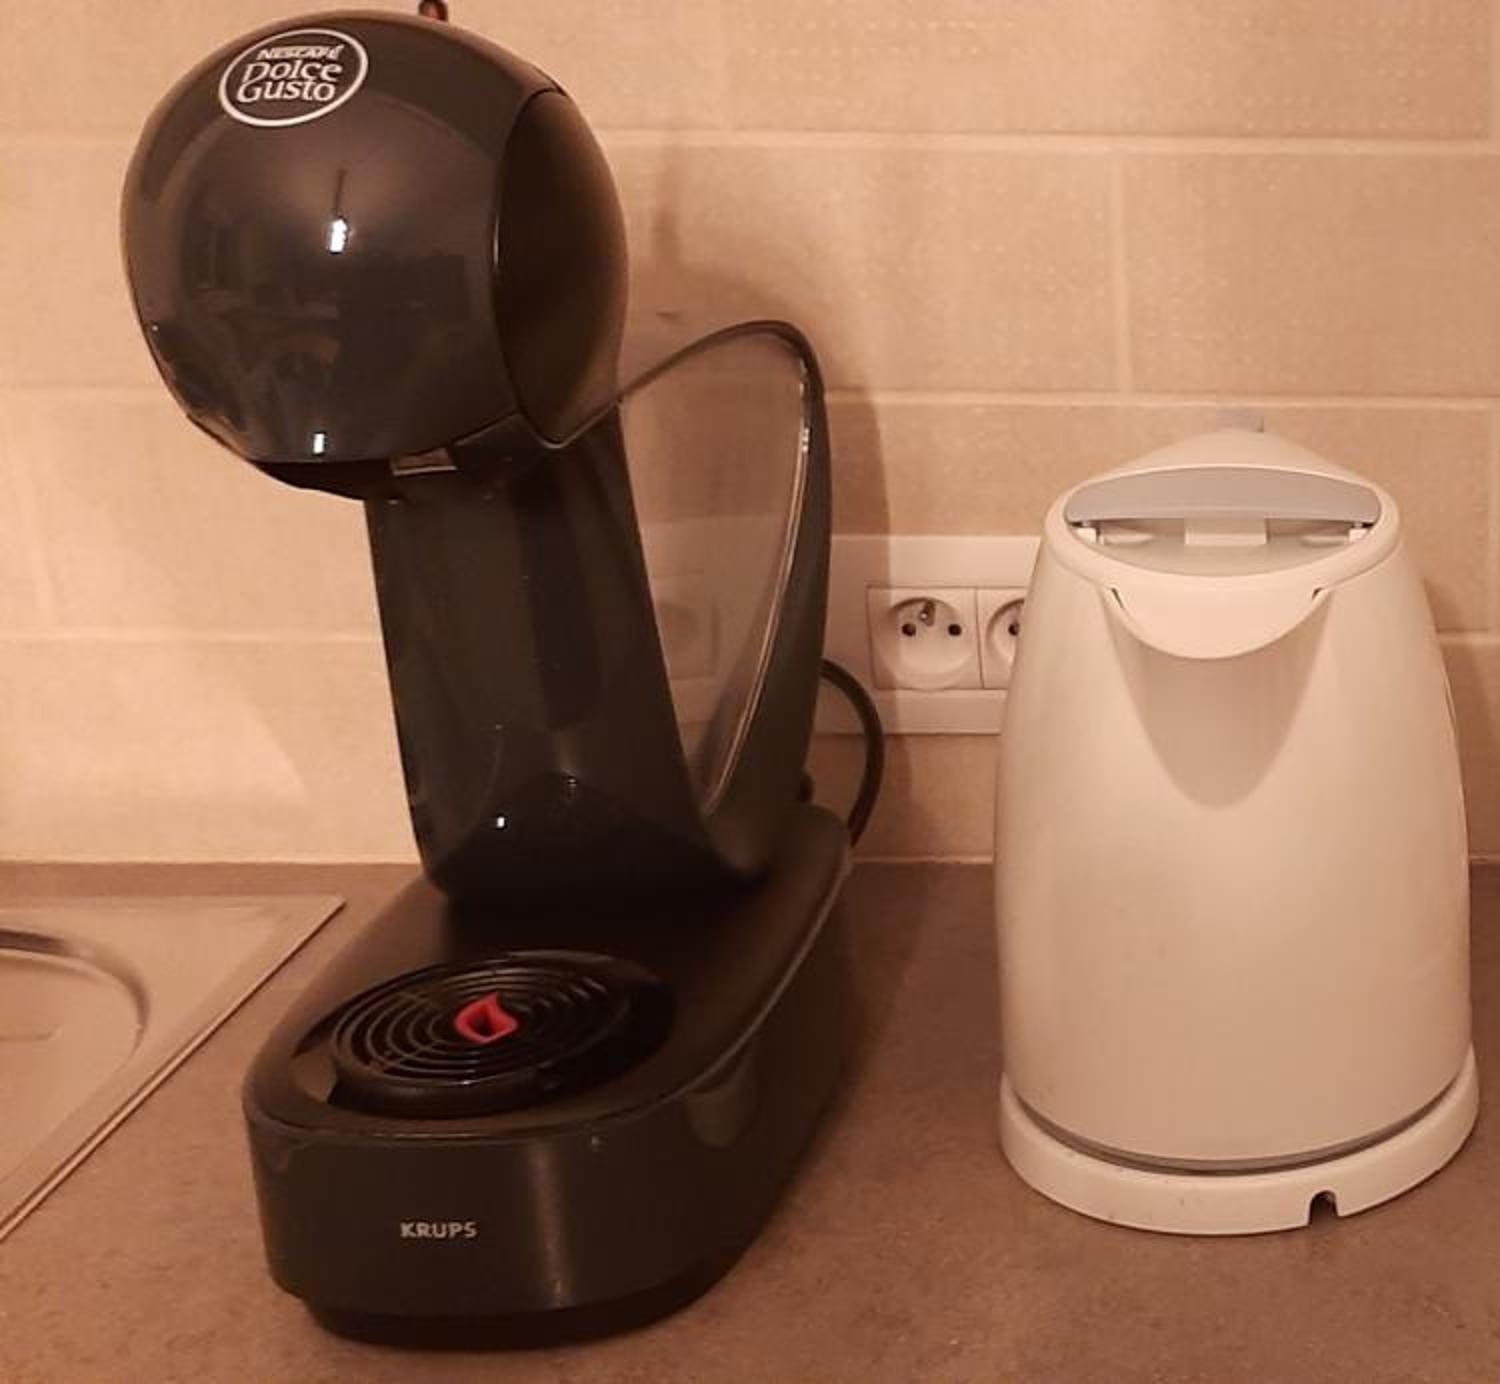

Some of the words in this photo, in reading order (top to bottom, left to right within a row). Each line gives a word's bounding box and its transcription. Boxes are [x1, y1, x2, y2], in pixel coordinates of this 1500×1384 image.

[242, 60, 343, 83] Dolce
[236, 80, 336, 103] Gusto
[400, 1220, 478, 1239] KRUPS
